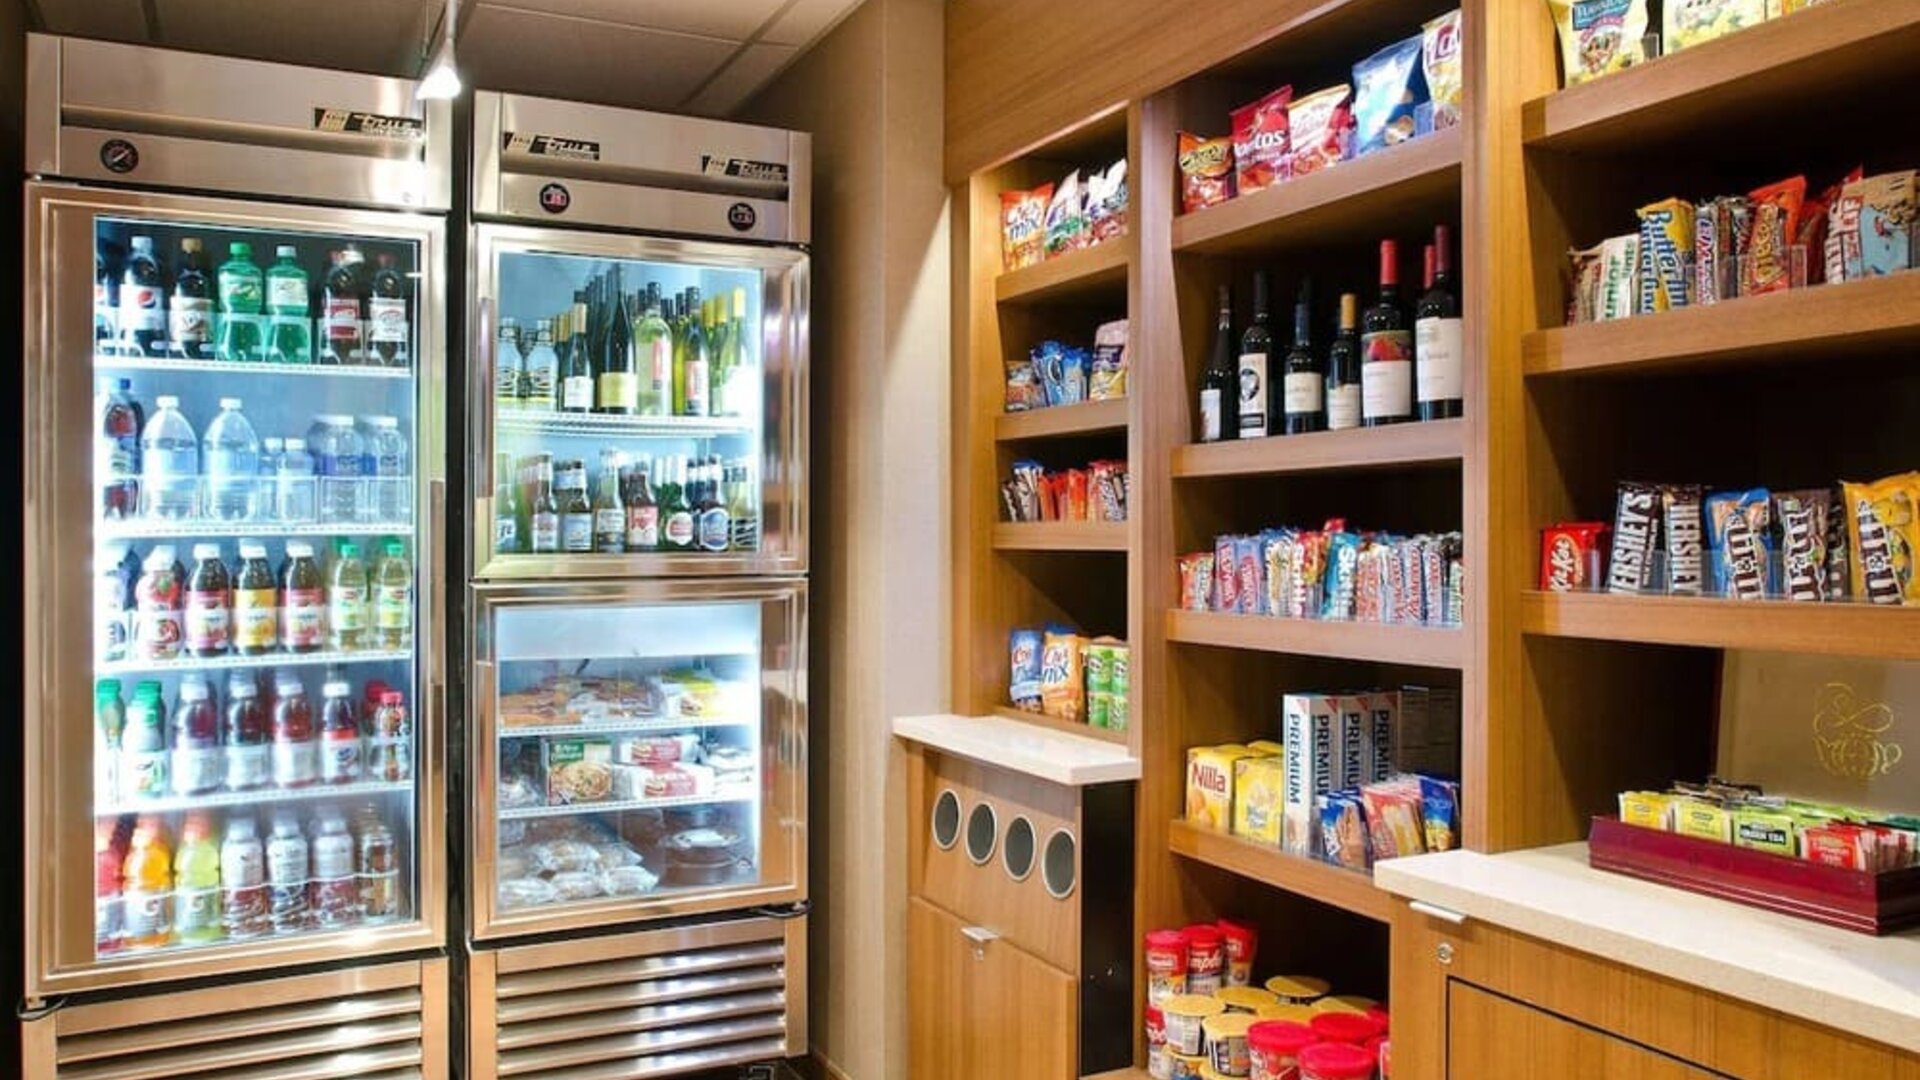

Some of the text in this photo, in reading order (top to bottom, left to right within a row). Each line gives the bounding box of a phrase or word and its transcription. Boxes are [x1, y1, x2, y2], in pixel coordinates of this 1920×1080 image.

[1605, 256, 1620, 318] unior
[1668, 504, 1701, 594] HERSHEY
[1193, 762, 1227, 793] Nilla
[1289, 713, 1301, 804] PREMIUM
[1347, 712, 1361, 791] PREMIU
[1377, 709, 1390, 782] PREMIU
